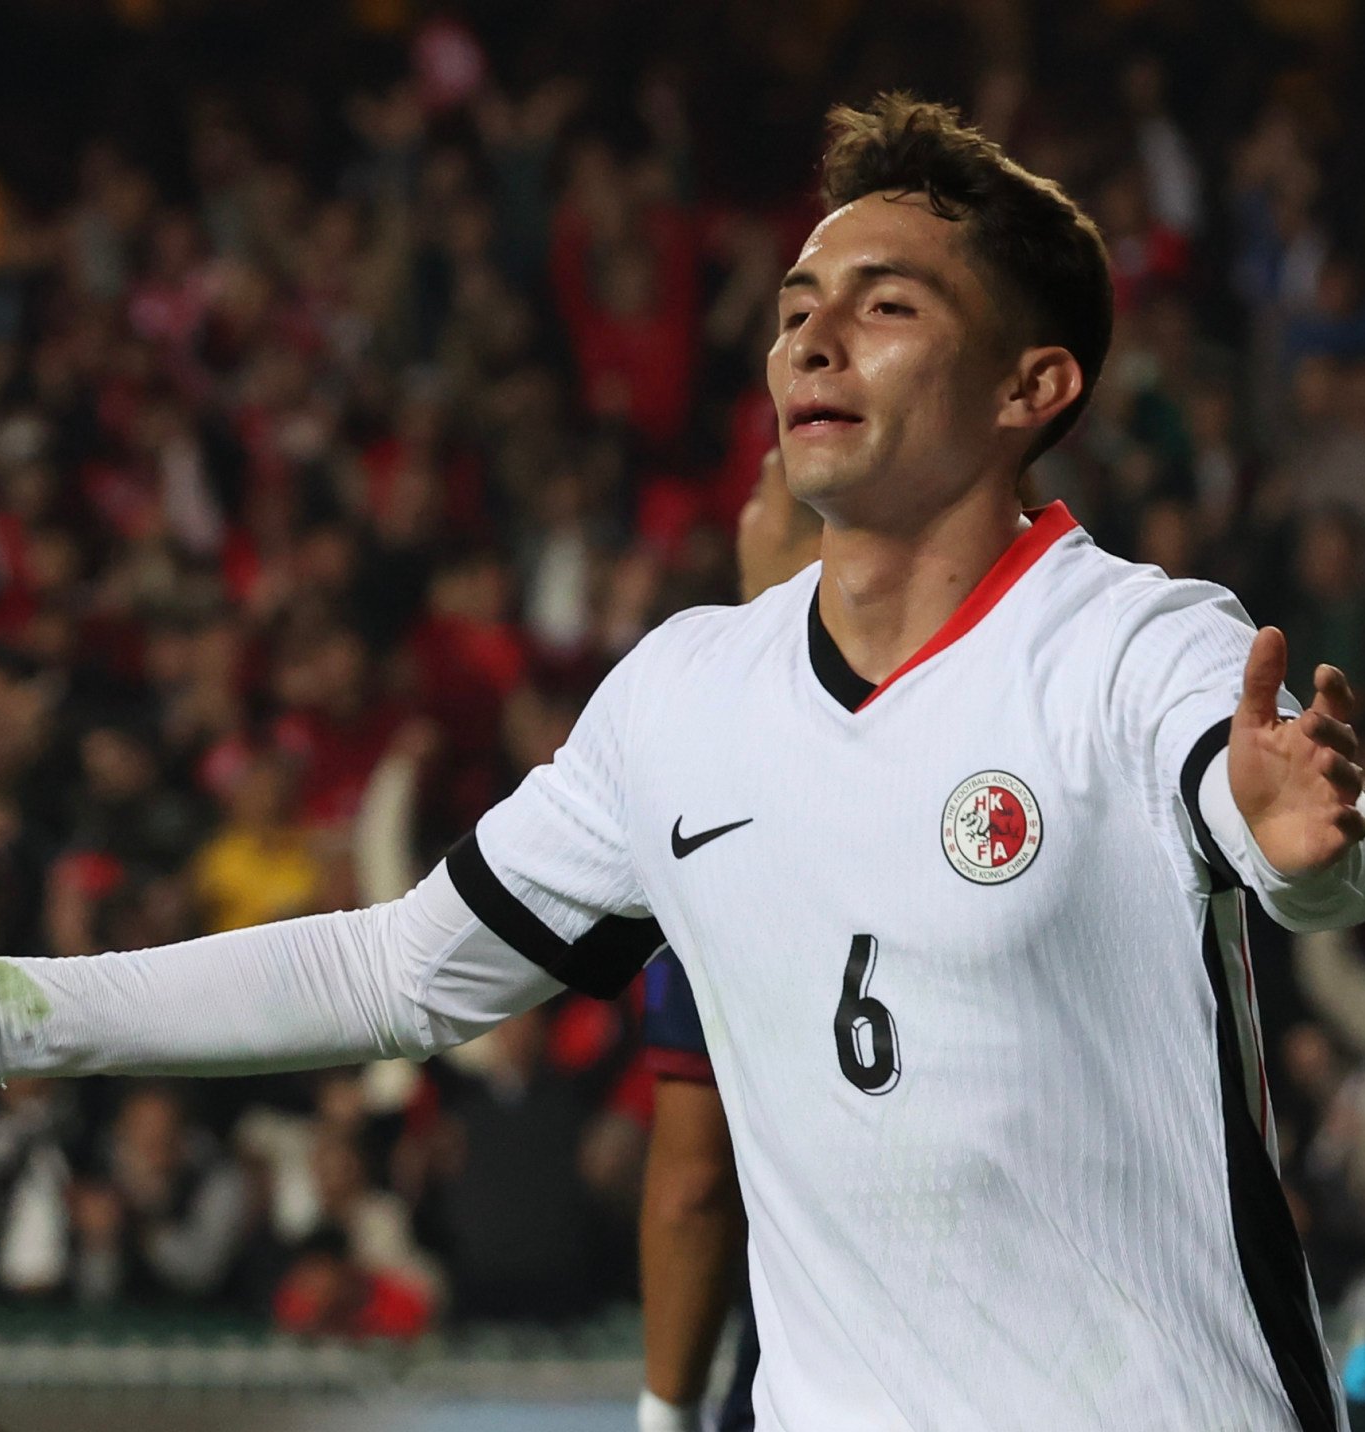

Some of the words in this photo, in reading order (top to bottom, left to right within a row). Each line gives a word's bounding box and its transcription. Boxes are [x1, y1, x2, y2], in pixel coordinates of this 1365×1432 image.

[946, 804, 955, 820] THE
[955, 776, 989, 804] FOOTBALL
[993, 775, 1033, 813] ASSOCIATION
[975, 793, 1004, 812] HK
[957, 858, 977, 877] HONG
[1007, 851, 1030, 874] CHINA
[977, 842, 1008, 861] FA
[834, 933, 902, 1097] 6
